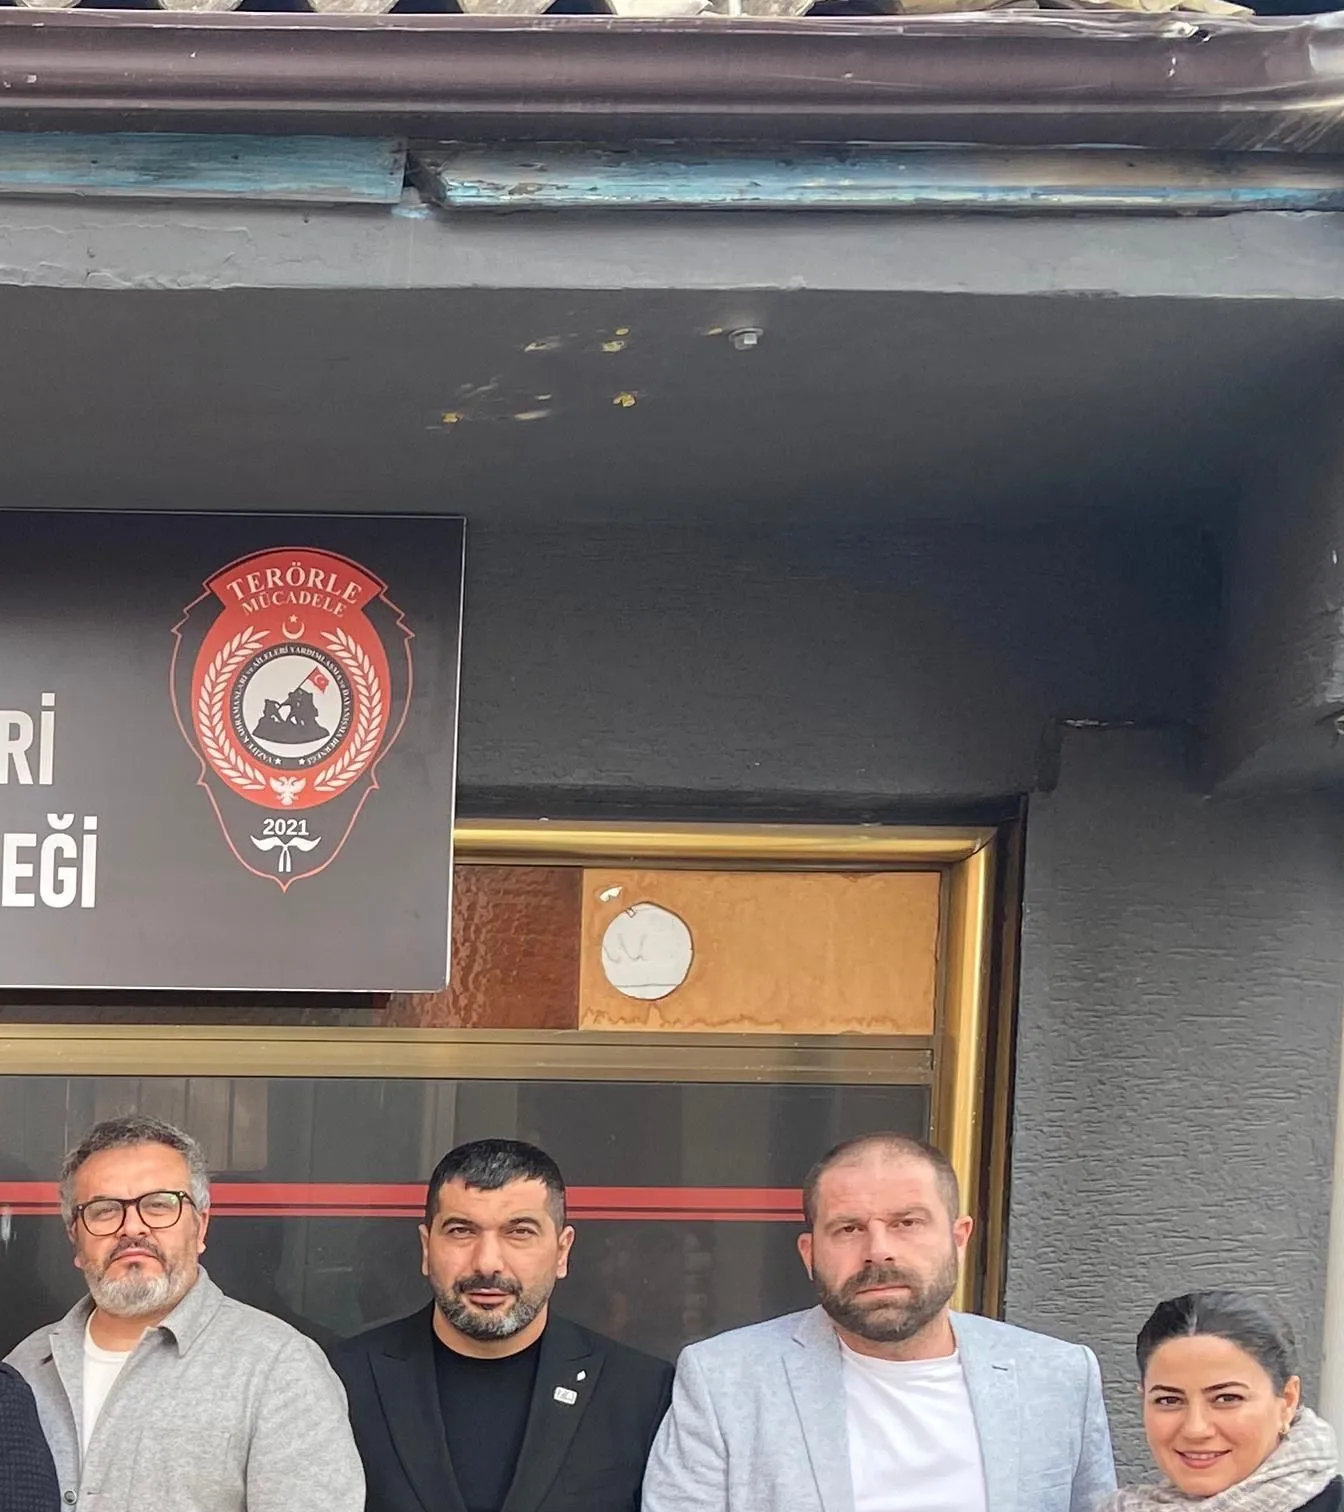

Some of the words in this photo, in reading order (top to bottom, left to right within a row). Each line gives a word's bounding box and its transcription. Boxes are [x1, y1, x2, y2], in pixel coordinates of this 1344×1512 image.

[226, 561, 362, 605] TERÖRLE
[241, 590, 348, 617] MÜCADELE
[262, 818, 310, 836] 2021
